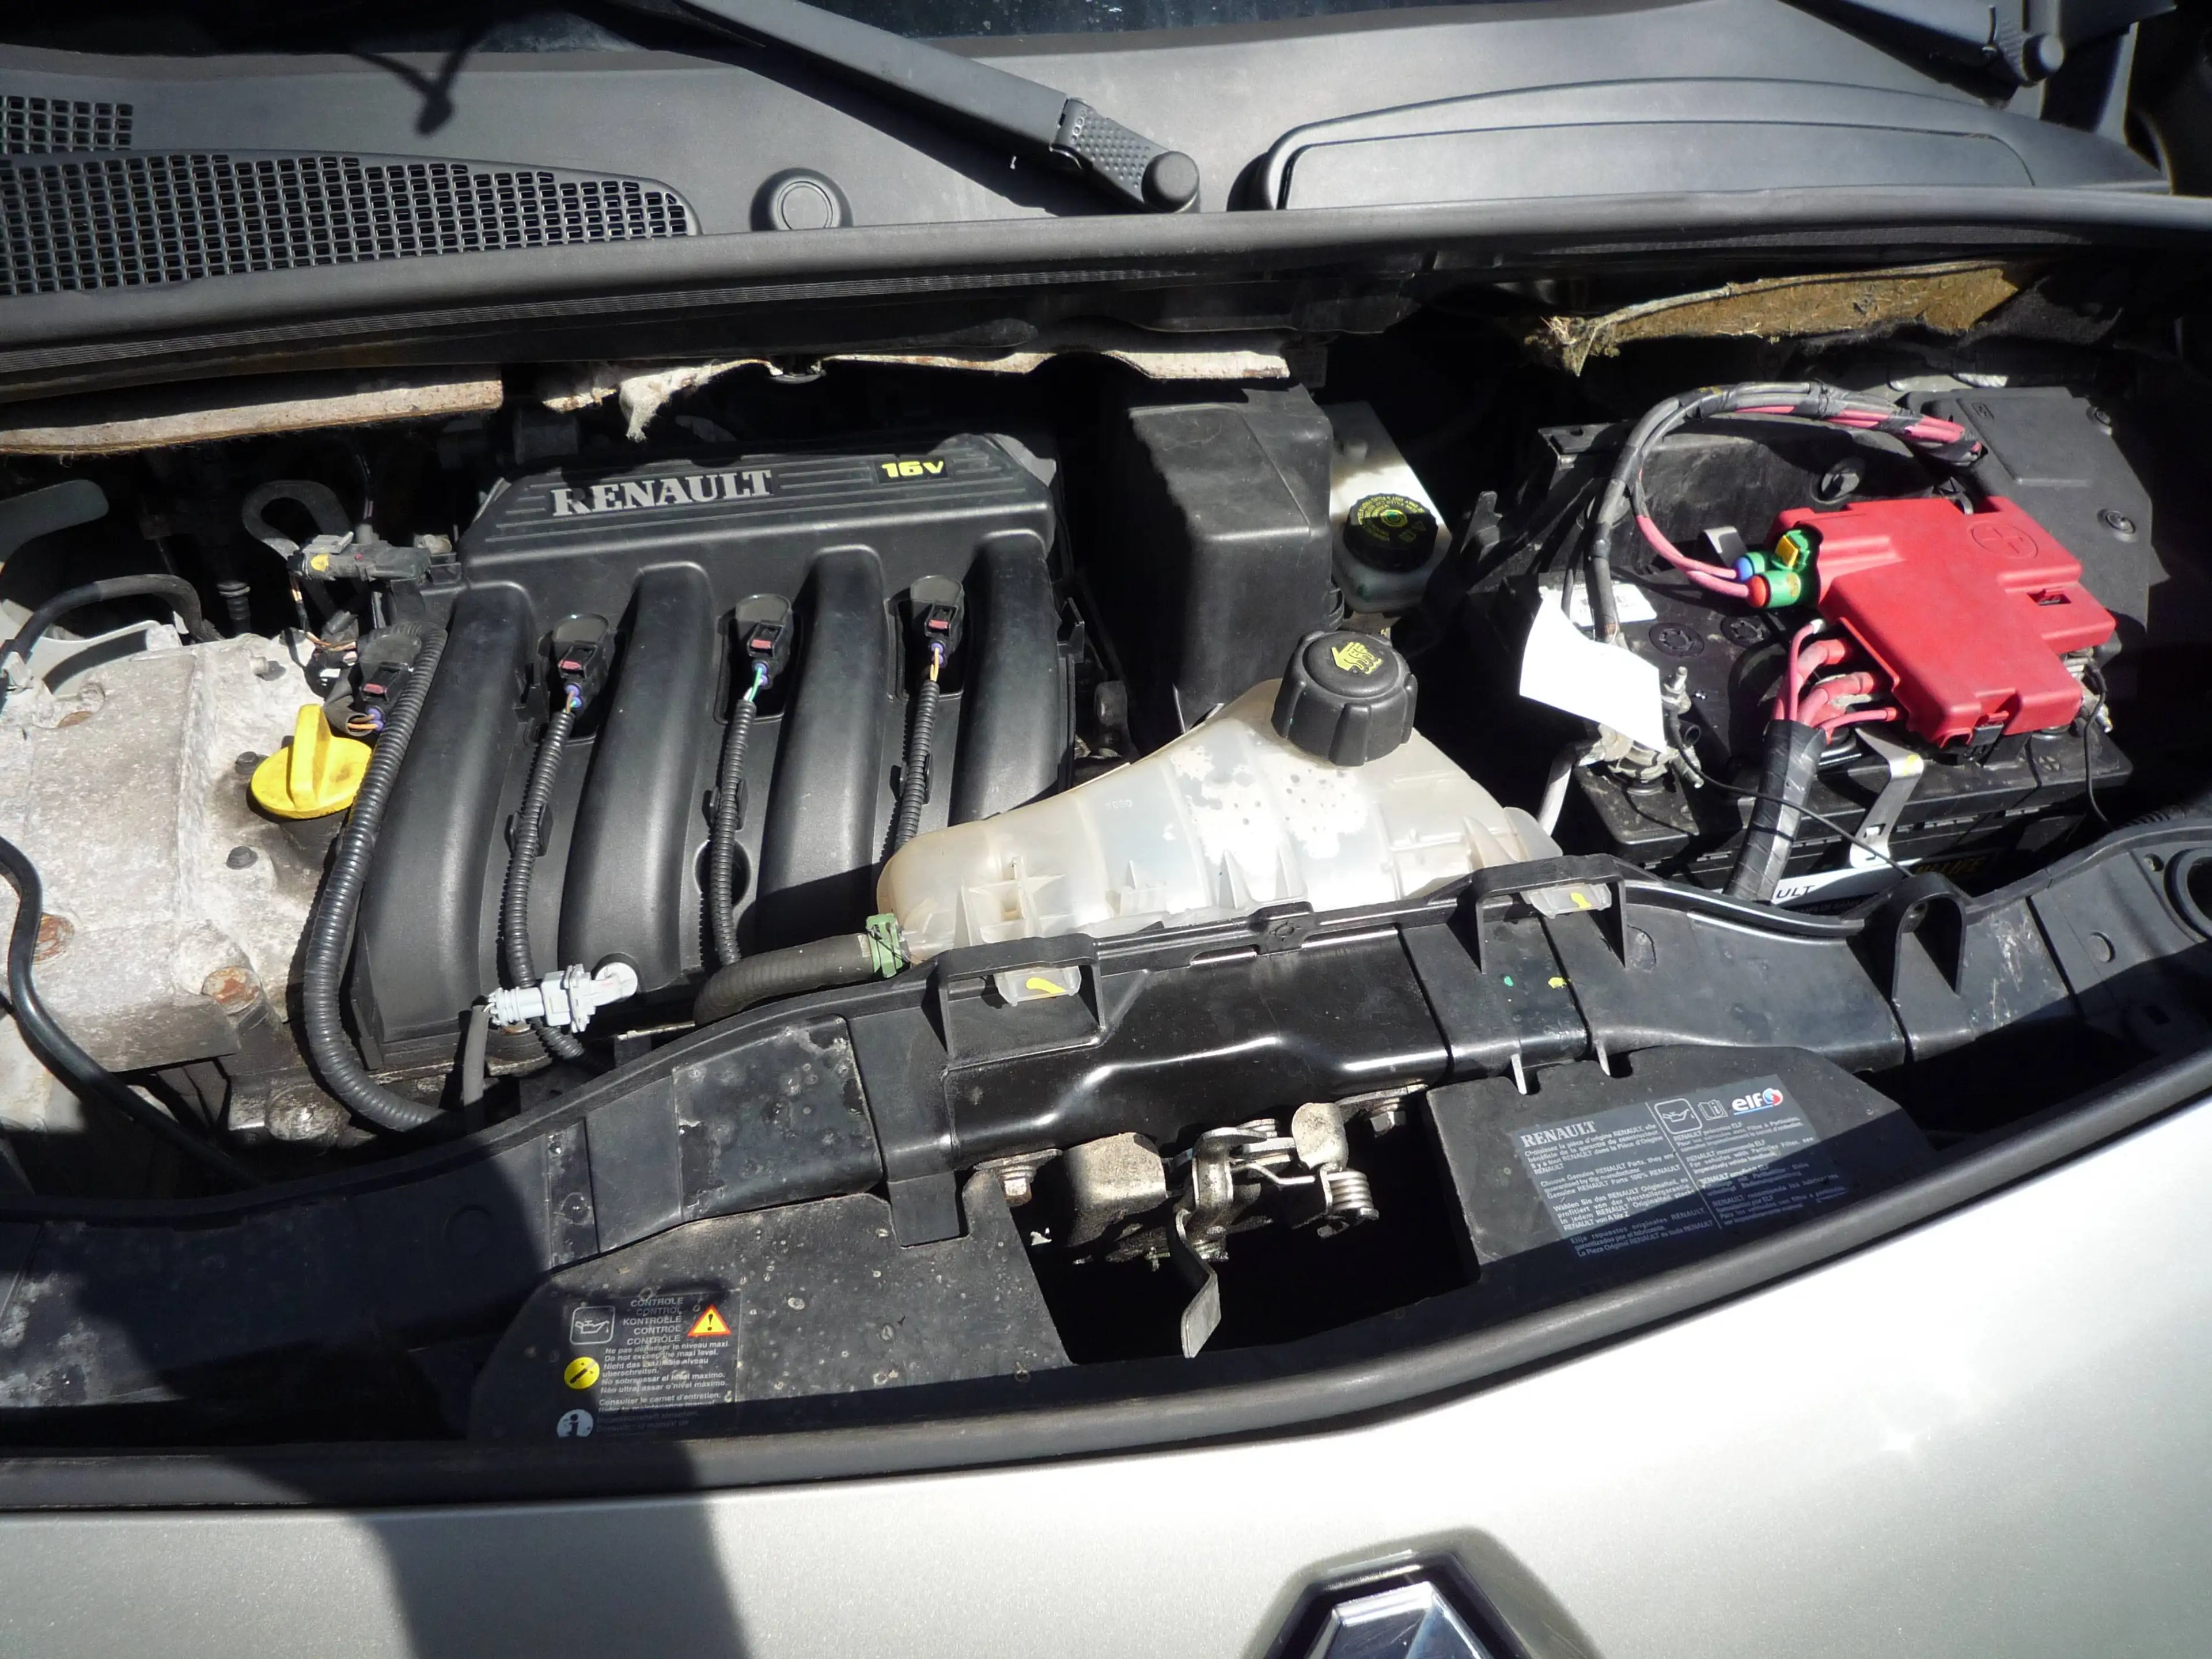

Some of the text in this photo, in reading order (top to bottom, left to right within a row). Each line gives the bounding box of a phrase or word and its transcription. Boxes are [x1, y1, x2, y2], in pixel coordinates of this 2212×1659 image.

[551, 470, 771, 516] RENAULT
[1732, 1092, 1763, 1112] elf
[1520, 1121, 1598, 1147] RENAULT
[1673, 1131, 1703, 1141] RENAULT
[1563, 1152, 1593, 1161] RENAULT
[1685, 1152, 1715, 1161] RENAULT
[1534, 1164, 1565, 1174] RENAULT
[1596, 1164, 1626, 1174] RENAULT
[1547, 1188, 1575, 1199] Genuine
[1577, 1181, 1609, 1192] RENAULT
[1649, 1165, 1681, 1176] RENAULT
[1608, 1188, 1639, 1199] RENAULT
[1596, 1205, 1630, 1215] RENAULT
[1563, 1219, 1594, 1230] RENAULT
[1629, 1233, 1660, 1244] RENAULT
[1683, 1220, 1715, 1232] RENAULT
[637, 1306, 680, 1316] CONTROL
[623, 1315, 682, 1327] KONTROLLE
[634, 1325, 681, 1335] CONTROL
[600, 1396, 638, 1407] Consulter
